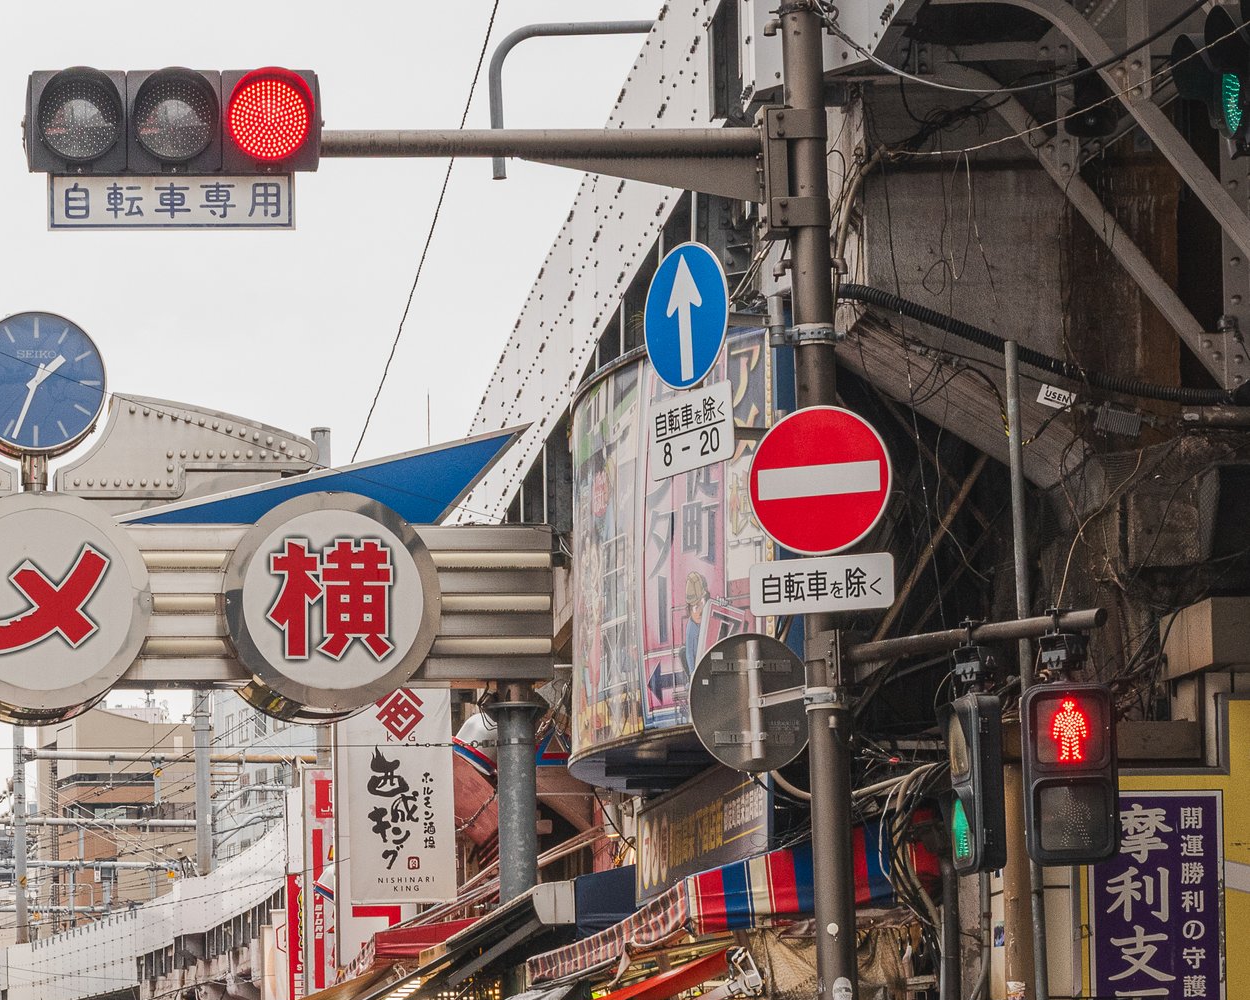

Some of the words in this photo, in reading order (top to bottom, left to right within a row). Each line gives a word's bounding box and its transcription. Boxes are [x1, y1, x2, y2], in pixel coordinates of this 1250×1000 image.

[63, 182, 283, 220] 自転車専用
[17, 350, 57, 359] SEIKO
[1045, 390, 1070, 403] USEN
[655, 396, 725, 438] 自転車を除く
[762, 566, 882, 604] 自転車を除く
[422, 772, 436, 848] ホルモン酒場
[378, 876, 435, 884] NISHINARI
